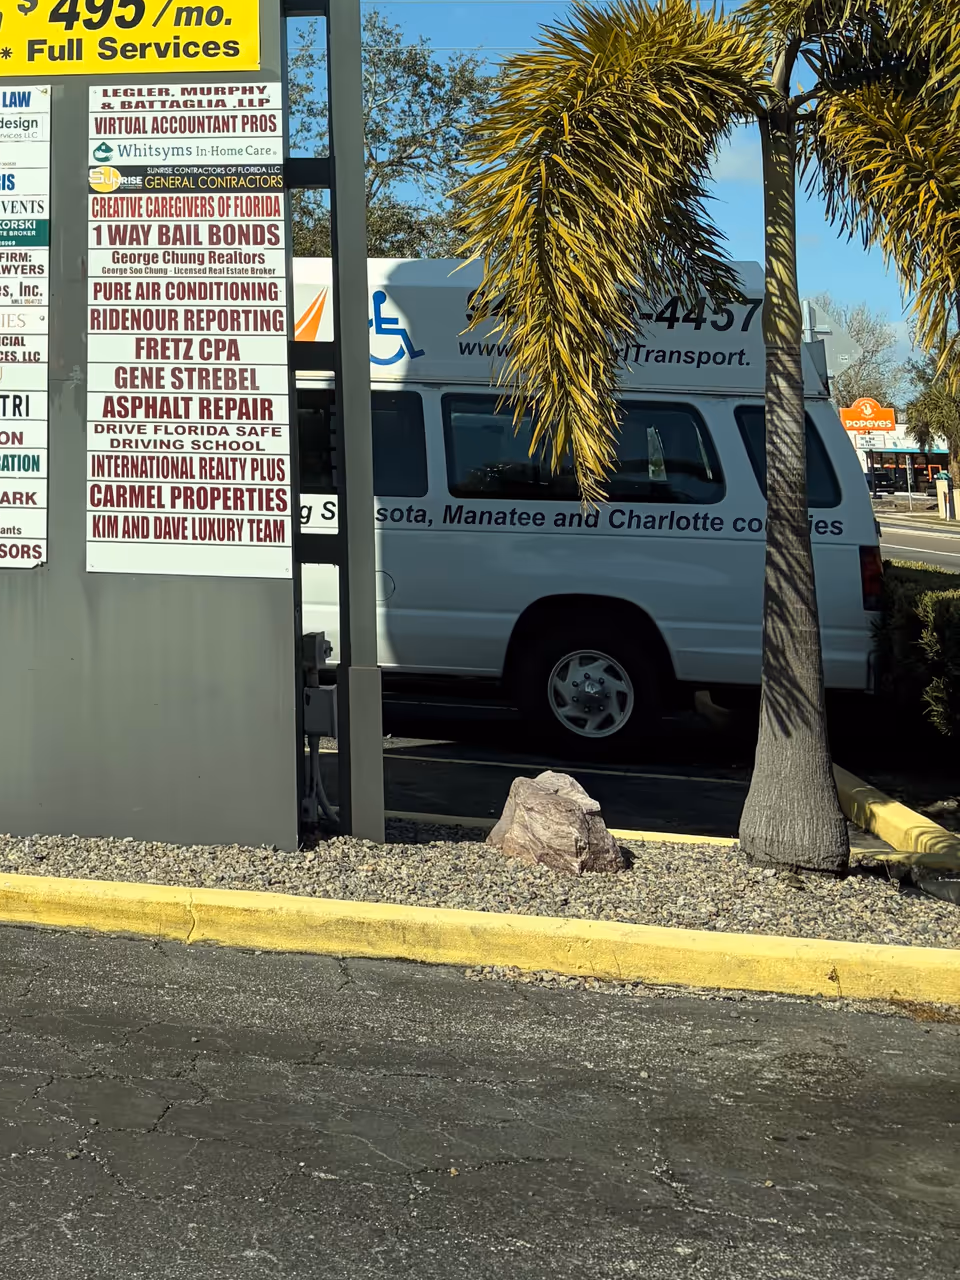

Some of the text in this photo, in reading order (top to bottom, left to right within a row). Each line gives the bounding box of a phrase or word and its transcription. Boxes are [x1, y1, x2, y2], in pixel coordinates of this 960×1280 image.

[27, 41, 83, 63] Full
[98, 36, 240, 60] Services
[2, 92, 31, 107] LAW
[95, 114, 277, 134] VIRTUAL ACCOUNTANT PROS
[118, 144, 271, 161] Whitsyms In-Home Care
[145, 177, 195, 188] GENERAL
[198, 175, 282, 188] CONTRACTORS
[92, 196, 281, 218] CREATIVE CAREGIVERS OF FLORIDA
[93, 224, 280, 246] 1 WAY BAIL BONDS
[0, 253, 32, 262] FIRM:
[112, 250, 265, 265] George Chung Realtors
[102, 267, 128, 275] George
[145, 267, 168, 275] Chung
[227, 267, 248, 275] Estate
[250, 267, 276, 275] Broker
[94, 282, 279, 301] PURE AIR CONDITIONING
[90, 309, 284, 332] RIDENOUR REPORTING
[135, 338, 240, 361] FRETZ CPA
[115, 366, 260, 391] GENE STREBEL
[102, 396, 273, 421] ASPHALT REPAIR
[91, 455, 285, 482] INTERNATIONAL REALTY PLUS
[90, 484, 288, 511] CARMEL PROPERTIES
[92, 515, 285, 542] KIM AND DAVE LUXURY TEAM
[442, 505, 546, 527] Manatee
[554, 510, 599, 527] and
[609, 510, 724, 531] Charlotte
